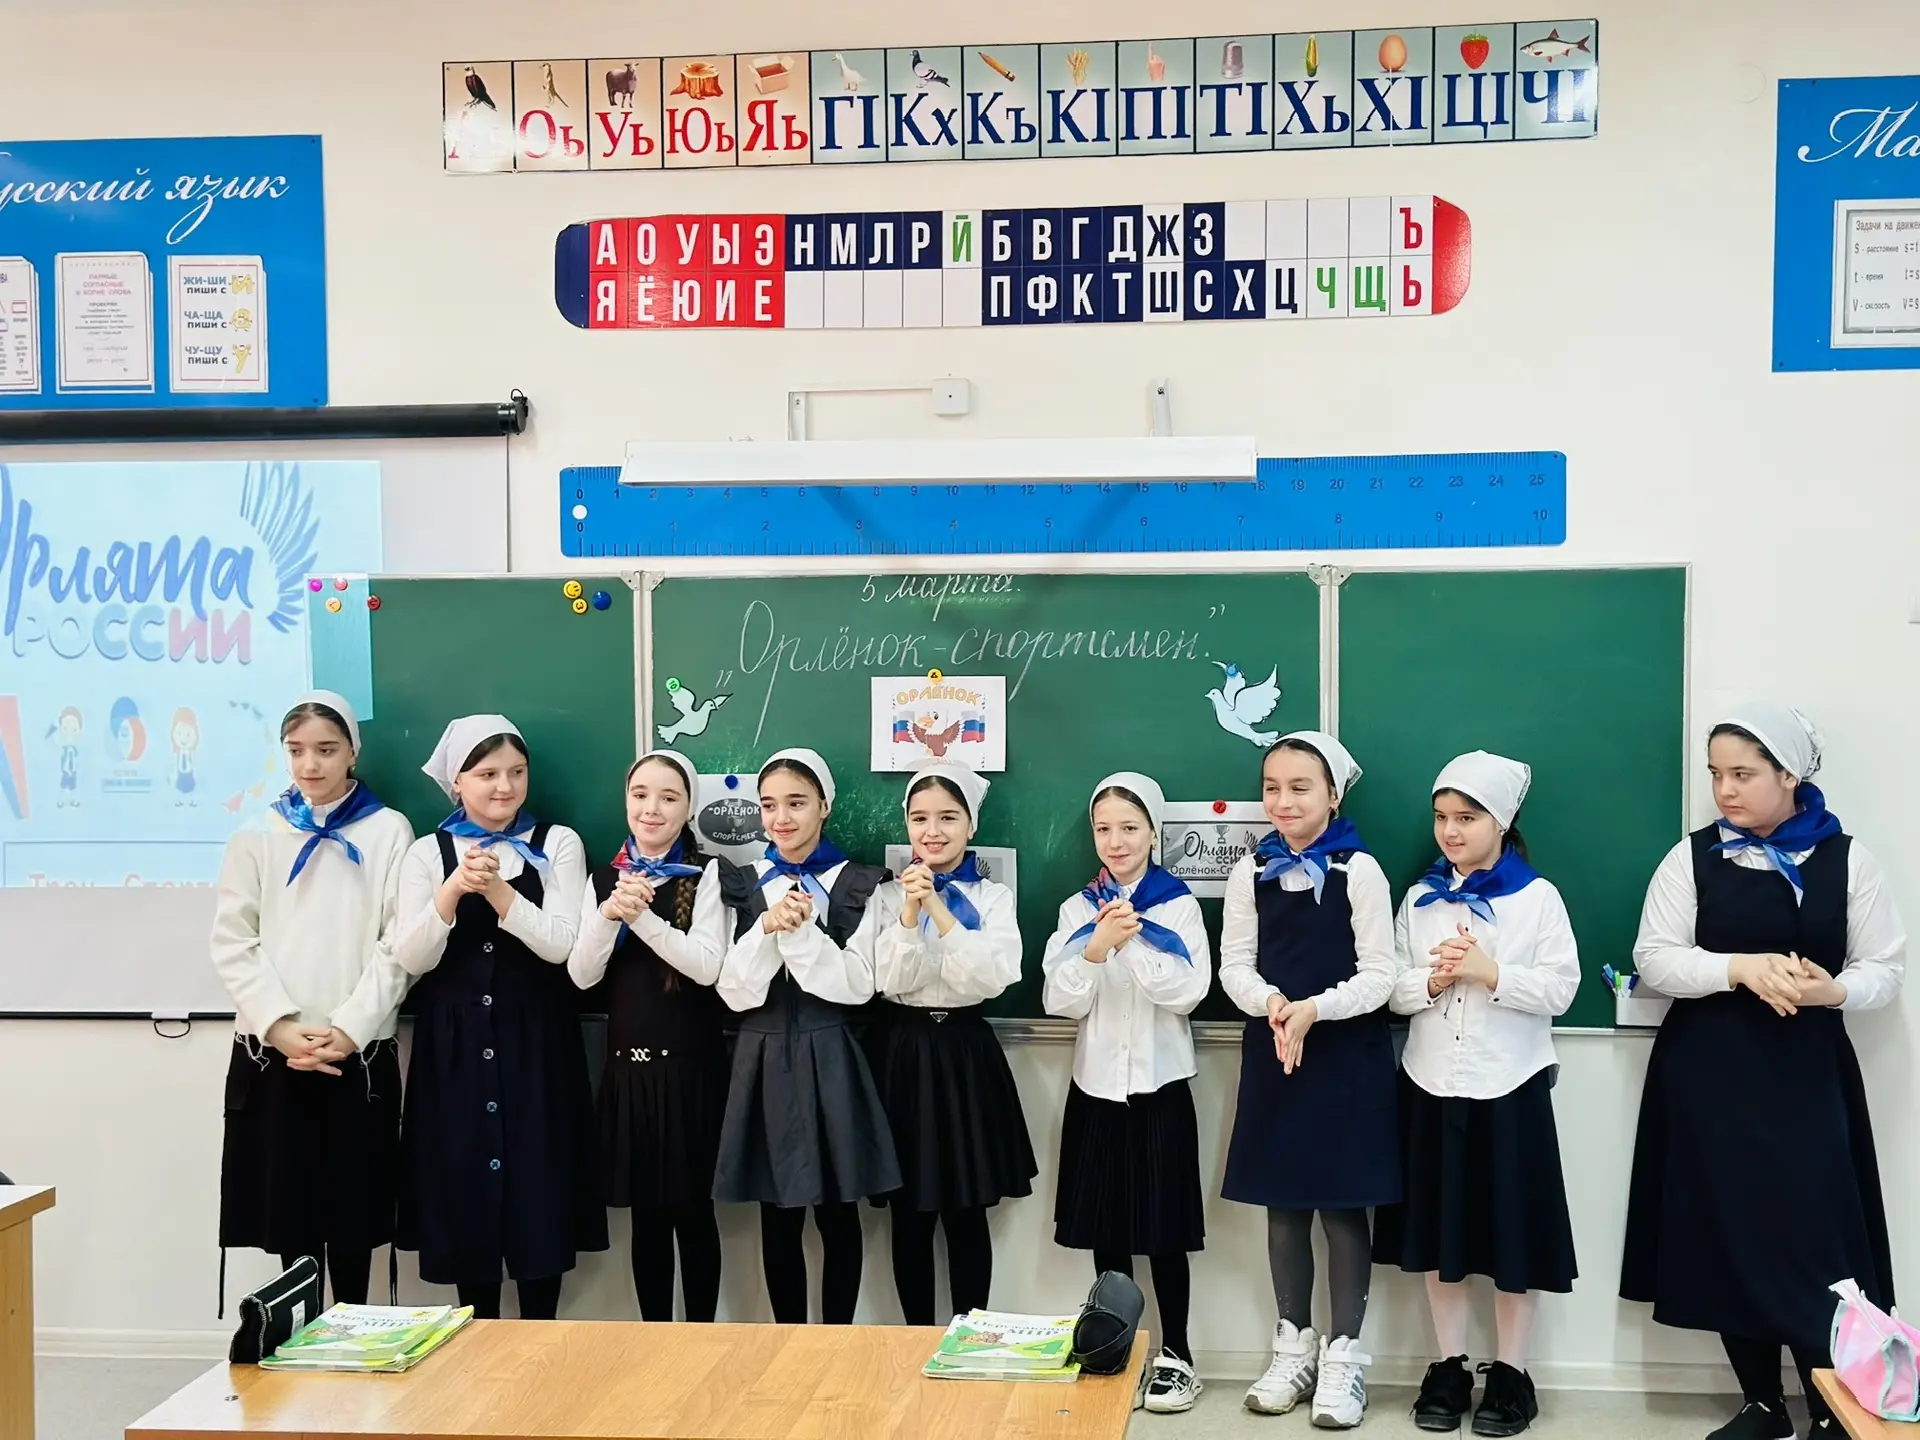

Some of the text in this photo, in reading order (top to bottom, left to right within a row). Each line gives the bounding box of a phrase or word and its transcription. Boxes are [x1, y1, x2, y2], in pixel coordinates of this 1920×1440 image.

[0, 152, 290, 245] усский язык
[596, 207, 1424, 266] А О У Ы Э Н М Л Р Й Б В Г Д Ж З Ъ
[1855, 220, 1881, 233] Задачи
[1884, 220, 1893, 231] на
[183, 276, 227, 286] ЖИ-ШИ
[596, 265, 1423, 322] Я Ё Ю И Е П Ф К Т Ш С Х Ц Ч Щ Ь
[183, 310, 224, 321] ЧА-ЩА
[184, 345, 223, 356] ЧУ-ЩУ
[576, 488, 584, 500] 0
[614, 488, 620, 499] 1
[723, 487, 732, 498] 4
[761, 486, 769, 498] 5
[798, 486, 807, 498] 6
[873, 486, 880, 497] 8
[910, 485, 918, 497] 9
[946, 485, 960, 496] 10
[984, 485, 996, 496] 11
[1020, 484, 1035, 495] 12
[1059, 484, 1073, 495] 13
[1097, 483, 1112, 494] 14
[1136, 482, 1150, 493] 15
[1174, 482, 1188, 493] 16
[1212, 481, 1227, 492] 17
[1251, 480, 1266, 491] 18
[1290, 479, 1305, 491] 19
[1329, 479, 1345, 490] 20
[1369, 478, 1384, 489] 21
[1408, 477, 1424, 488] 22
[1448, 476, 1464, 487] 23
[1488, 475, 1504, 486] 24
[1529, 474, 1544, 485] 25
[576, 510, 1548, 533] 0 1 2 3 4 5 6 7 8 9 10
[0, 463, 253, 636] рлята
[861, 574, 883, 602] 5
[1184, 831, 1247, 860] Орлята
